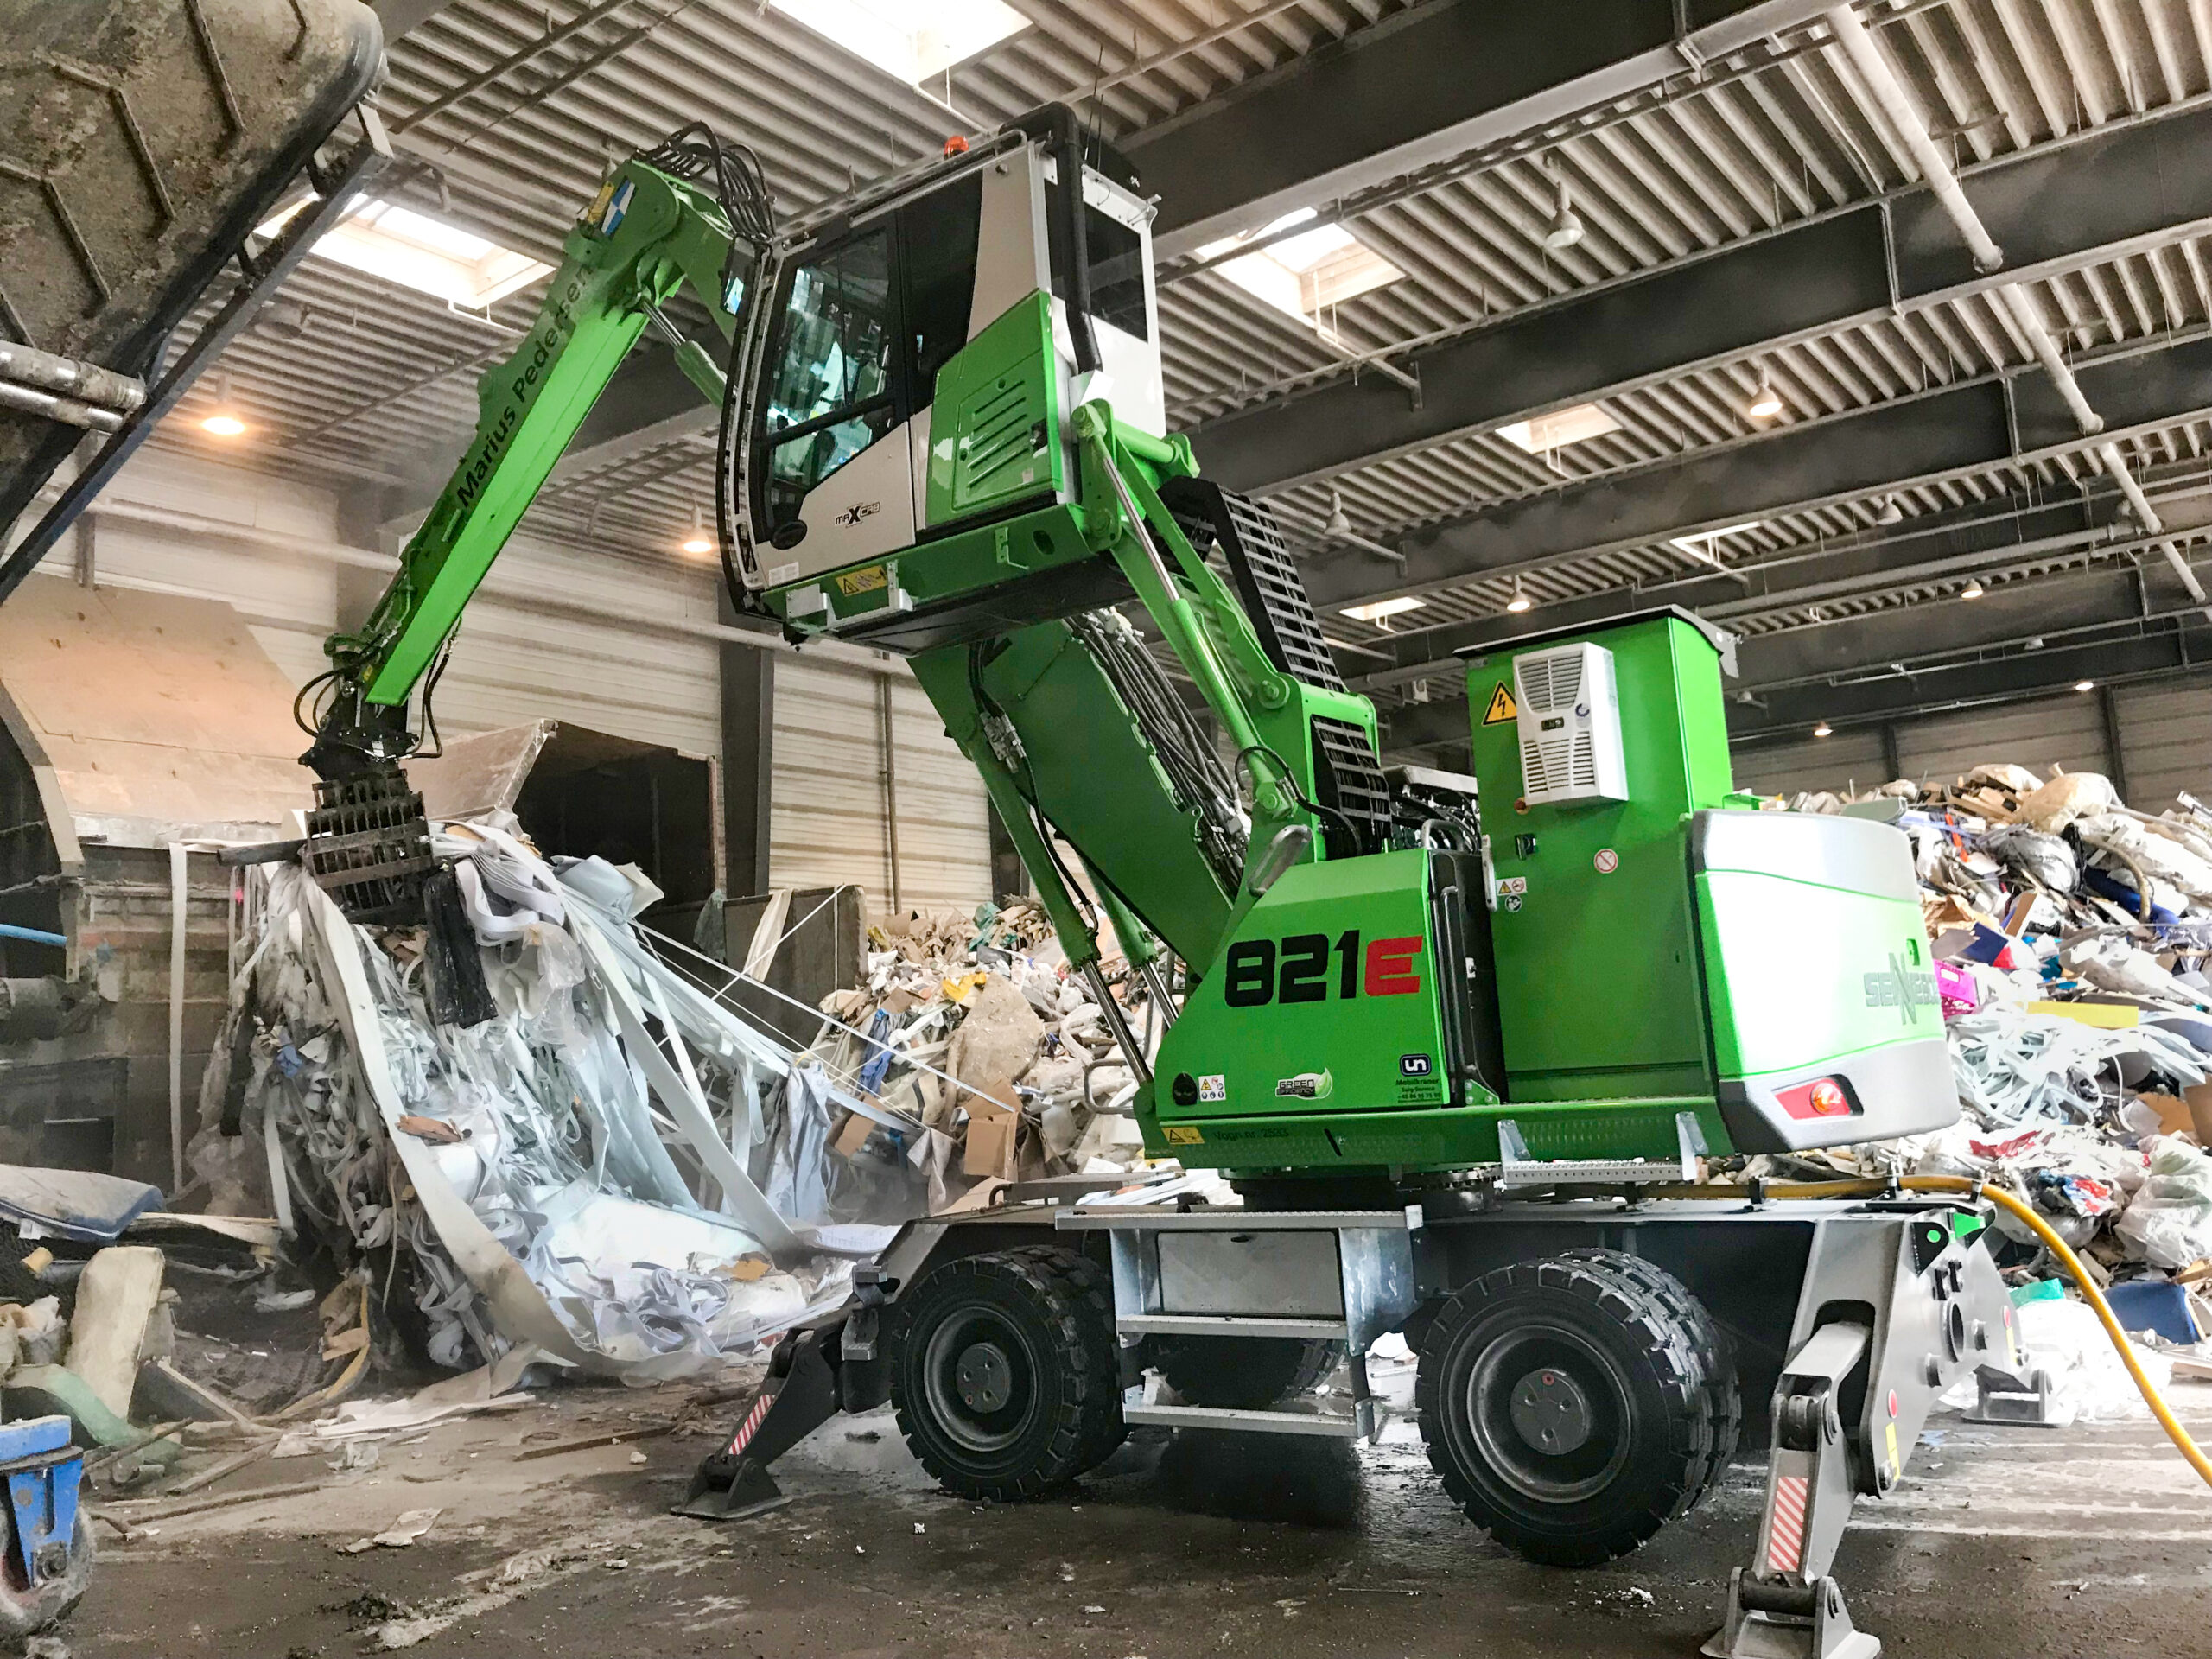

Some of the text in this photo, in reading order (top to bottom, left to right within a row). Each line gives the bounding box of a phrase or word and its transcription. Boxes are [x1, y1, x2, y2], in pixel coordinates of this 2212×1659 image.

[456, 264, 594, 508] Marius Pedersen
[1224, 929, 1424, 1008] 821E
[1279, 1079, 1314, 1089] GREEN
